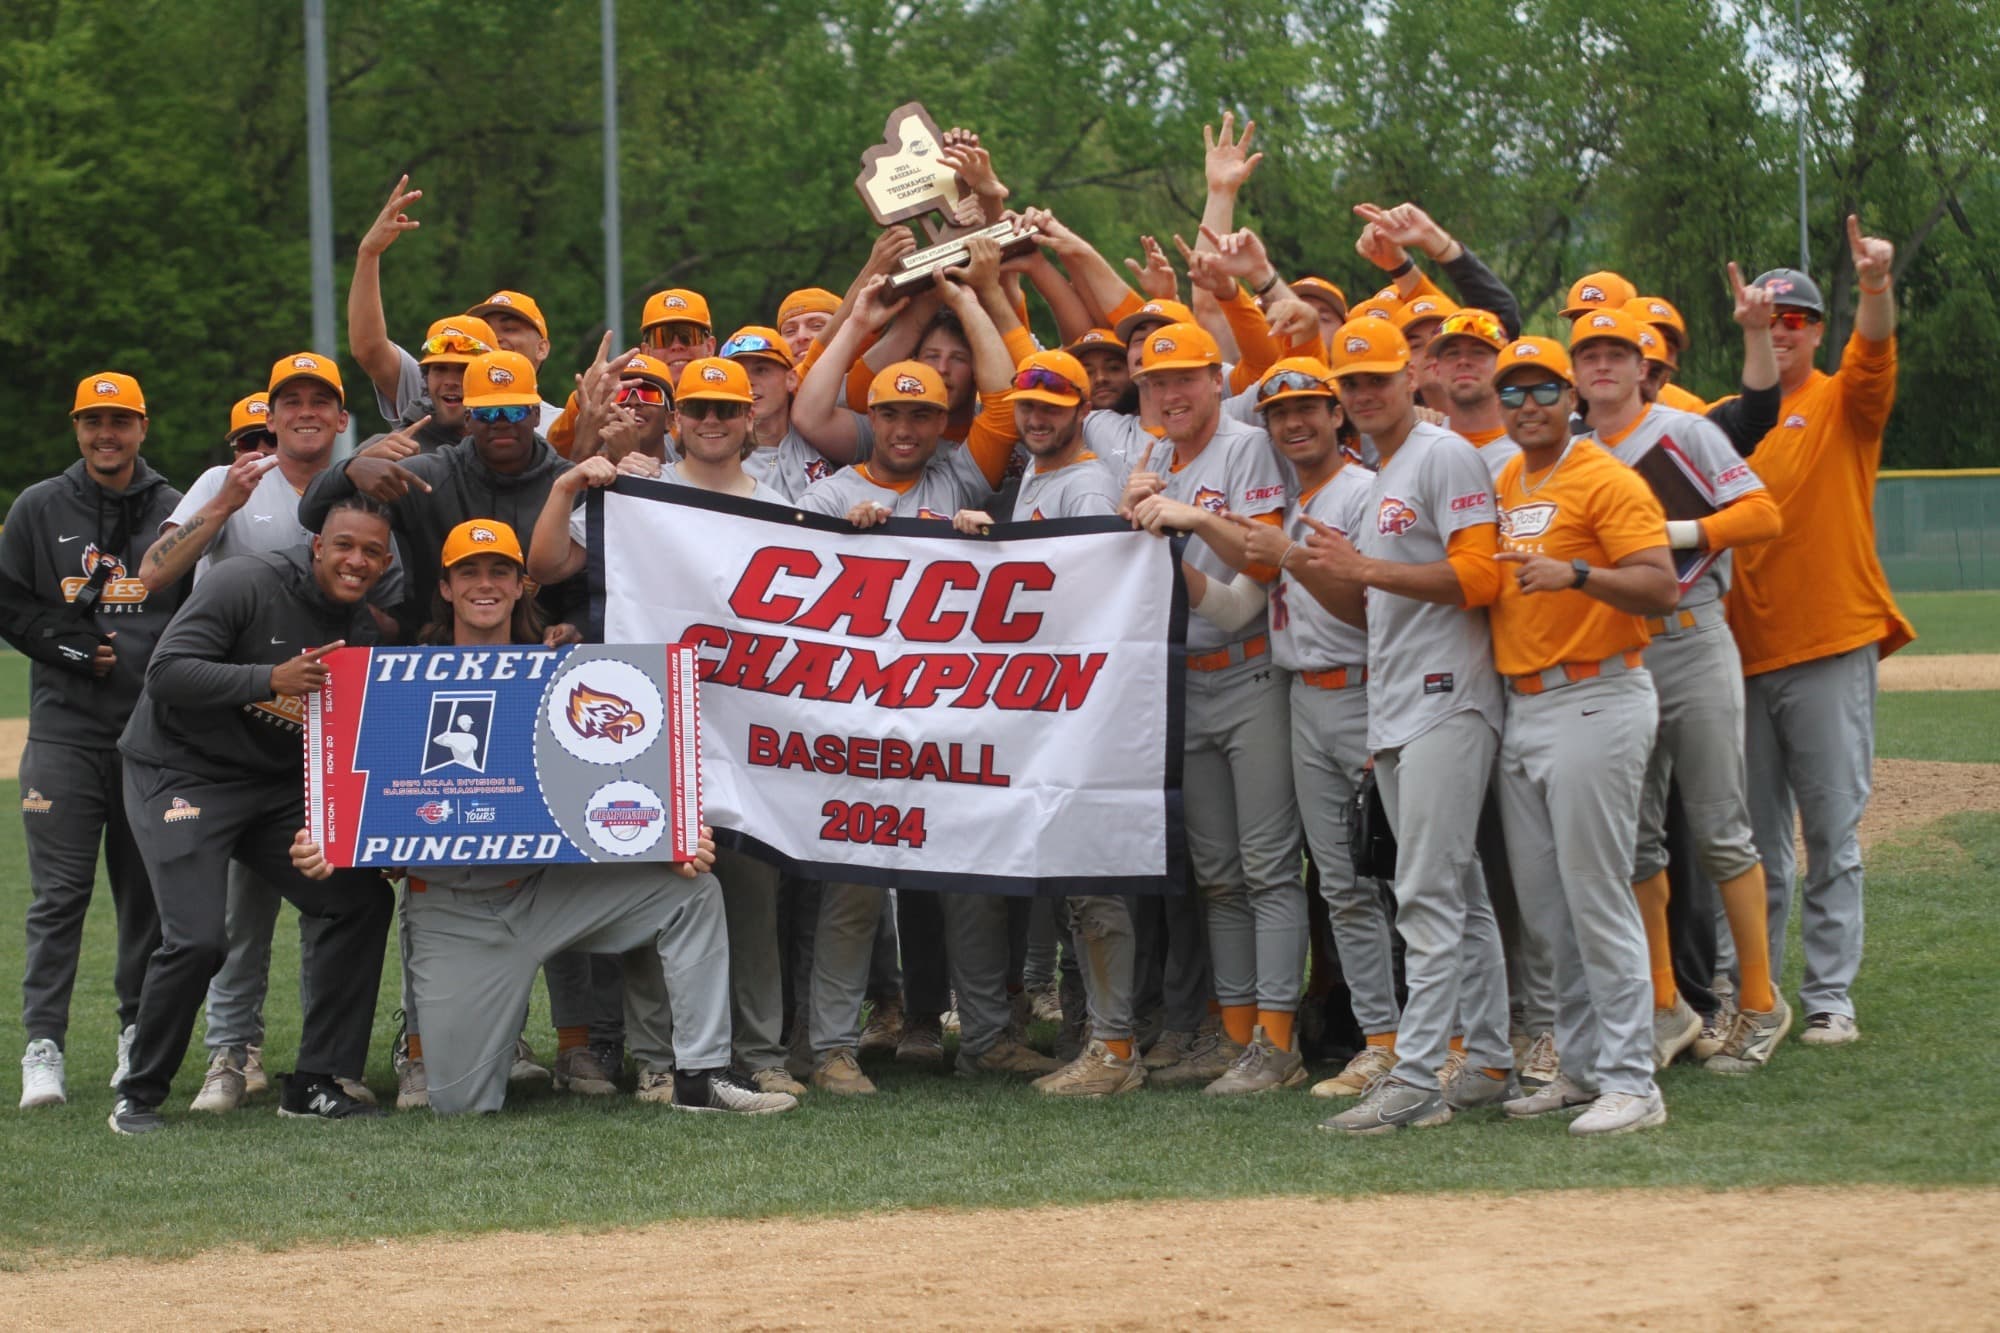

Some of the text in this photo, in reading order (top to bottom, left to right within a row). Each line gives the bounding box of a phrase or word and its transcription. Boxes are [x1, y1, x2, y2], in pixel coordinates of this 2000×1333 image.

[1245, 484, 1285, 501] CACC
[1451, 492, 1488, 511] CACC
[728, 545, 1056, 643] CACC
[375, 650, 558, 683] TICKET
[679, 623, 1109, 712] CHAMPION
[674, 737, 682, 788] TOURNAMENT
[748, 724, 1011, 787] BASEBALL
[383, 786, 525, 796] BASEBALL CHAMPIONSHIP
[457, 778, 506, 786] DIVISION
[464, 809, 497, 823] YOURS
[820, 800, 927, 848] 2024
[359, 834, 563, 863] PUNCHED
